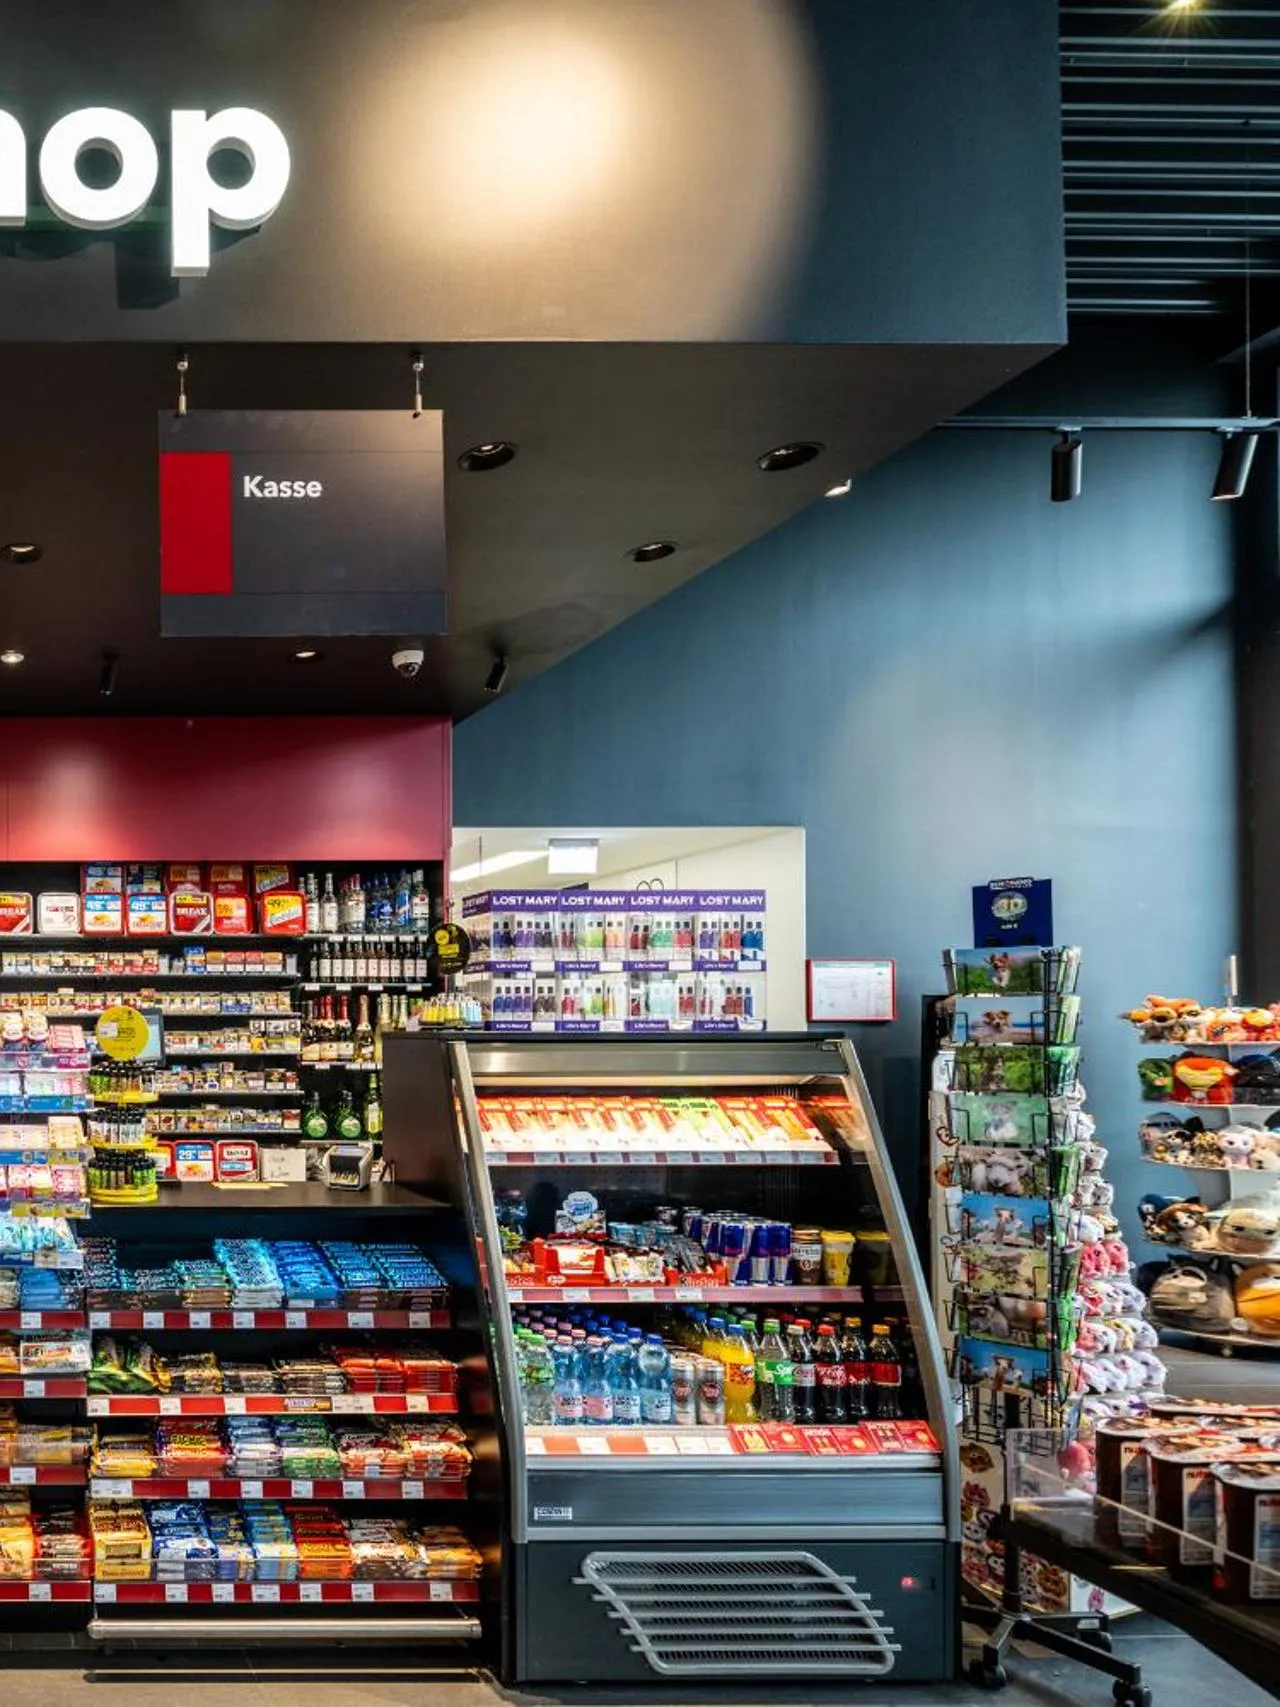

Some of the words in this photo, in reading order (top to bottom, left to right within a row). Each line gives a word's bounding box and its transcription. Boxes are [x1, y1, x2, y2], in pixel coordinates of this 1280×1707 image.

[243, 475, 323, 498] Kasse
[492, 895, 522, 905] LOST
[525, 895, 557, 905] MARY
[561, 895, 592, 906] LOST
[593, 895, 626, 906] MARY
[630, 895, 662, 906] LOST
[663, 895, 696, 906] MARY
[699, 895, 731, 906] LOST
[732, 895, 764, 906] MARY
